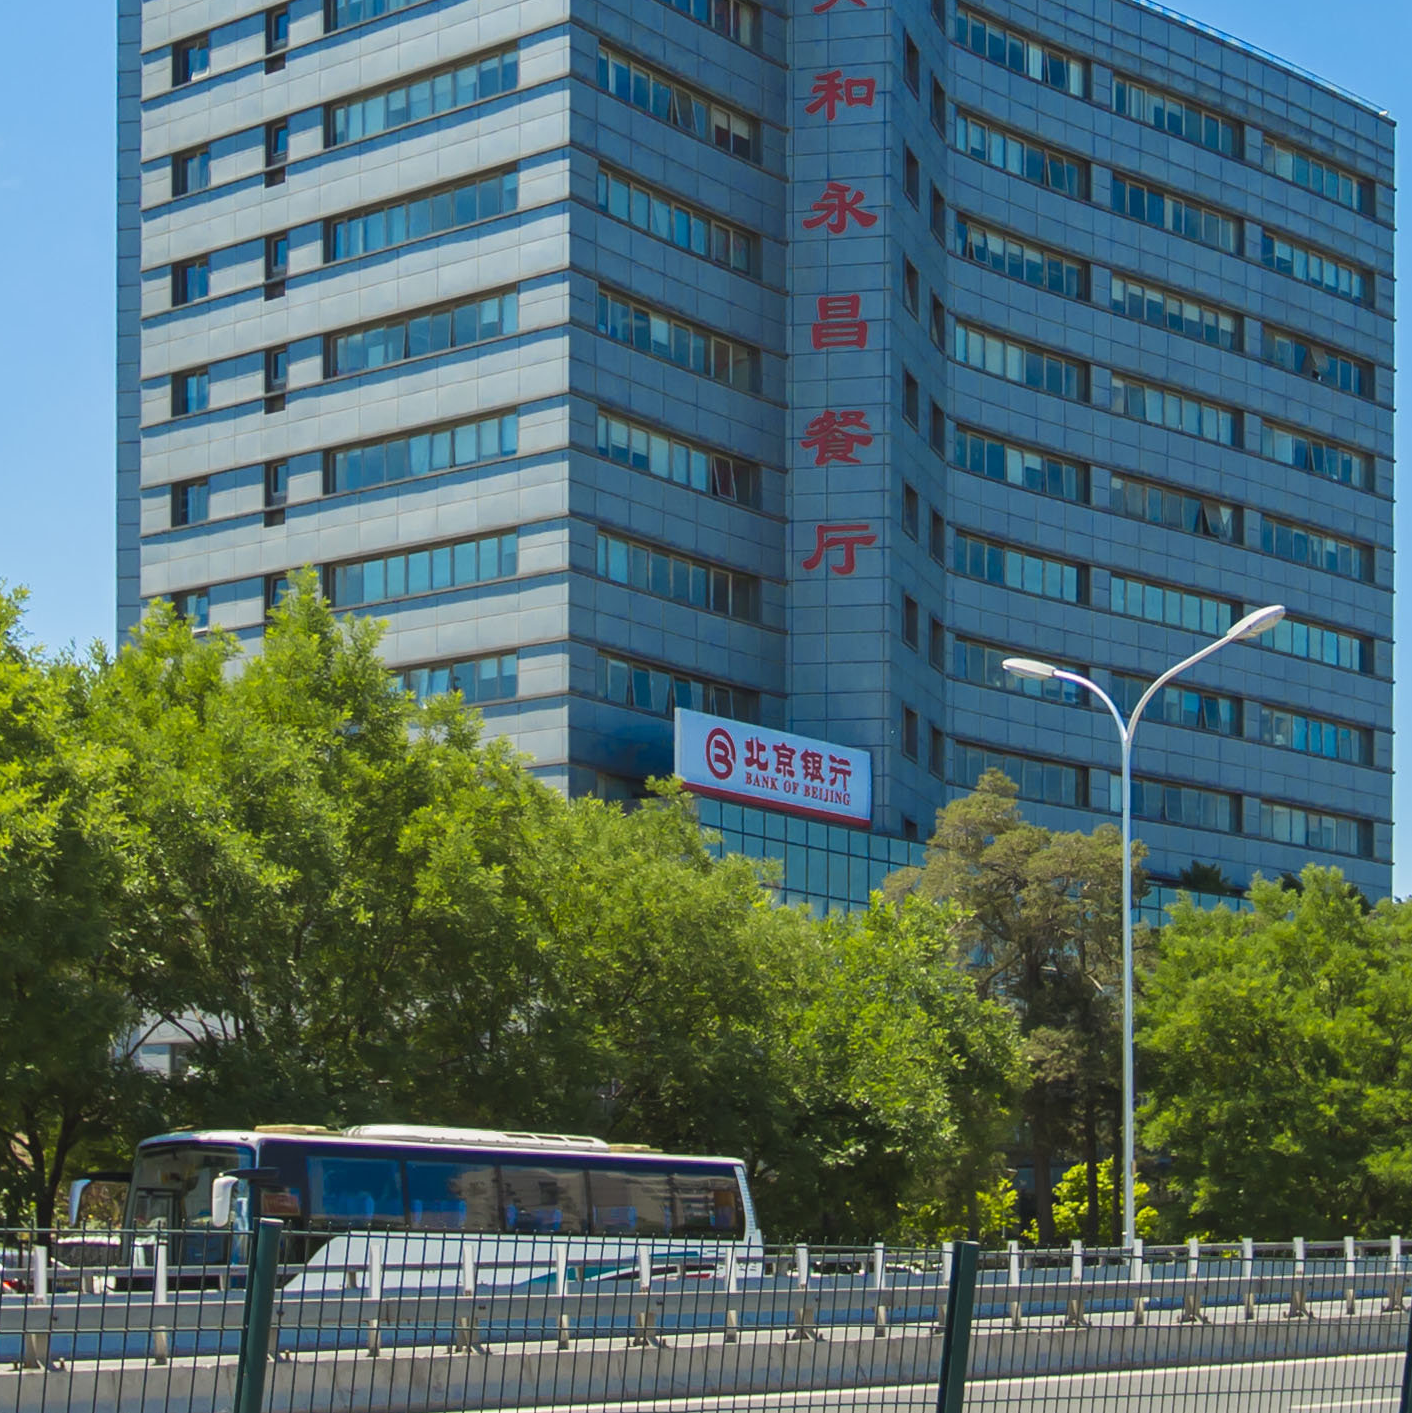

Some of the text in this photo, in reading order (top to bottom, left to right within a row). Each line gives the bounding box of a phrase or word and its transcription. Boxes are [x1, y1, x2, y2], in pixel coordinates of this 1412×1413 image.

[745, 772, 851, 806] BANK OF BEIJING
